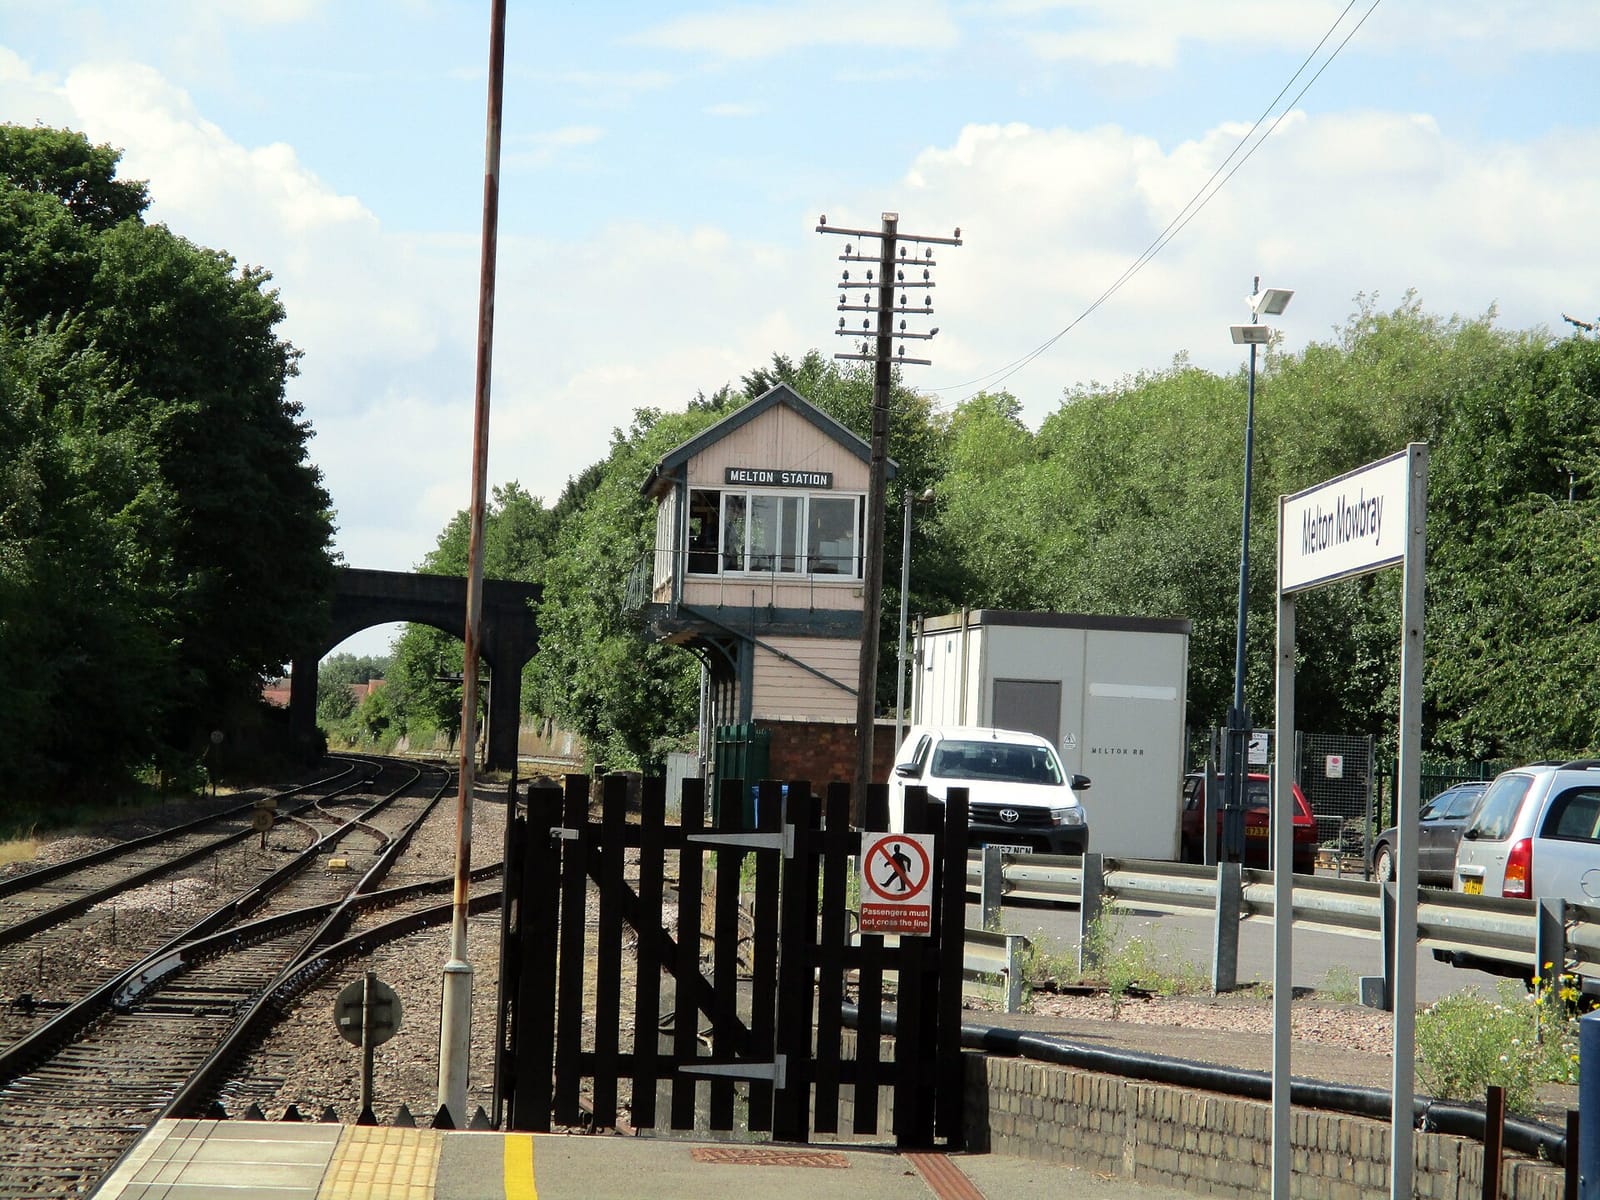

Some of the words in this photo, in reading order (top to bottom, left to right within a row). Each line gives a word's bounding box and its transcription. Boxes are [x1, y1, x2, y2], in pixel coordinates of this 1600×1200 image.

[730, 470, 774, 483] MELTON
[781, 472, 828, 485] STATION
[1301, 503, 1334, 556] Melton
[1336, 487, 1384, 547] Mowbray
[1091, 747, 1128, 755] MELTON
[862, 907, 908, 917] Passengers
[908, 909, 929, 917] must
[900, 919, 912, 927] the
[913, 919, 928, 927] line
